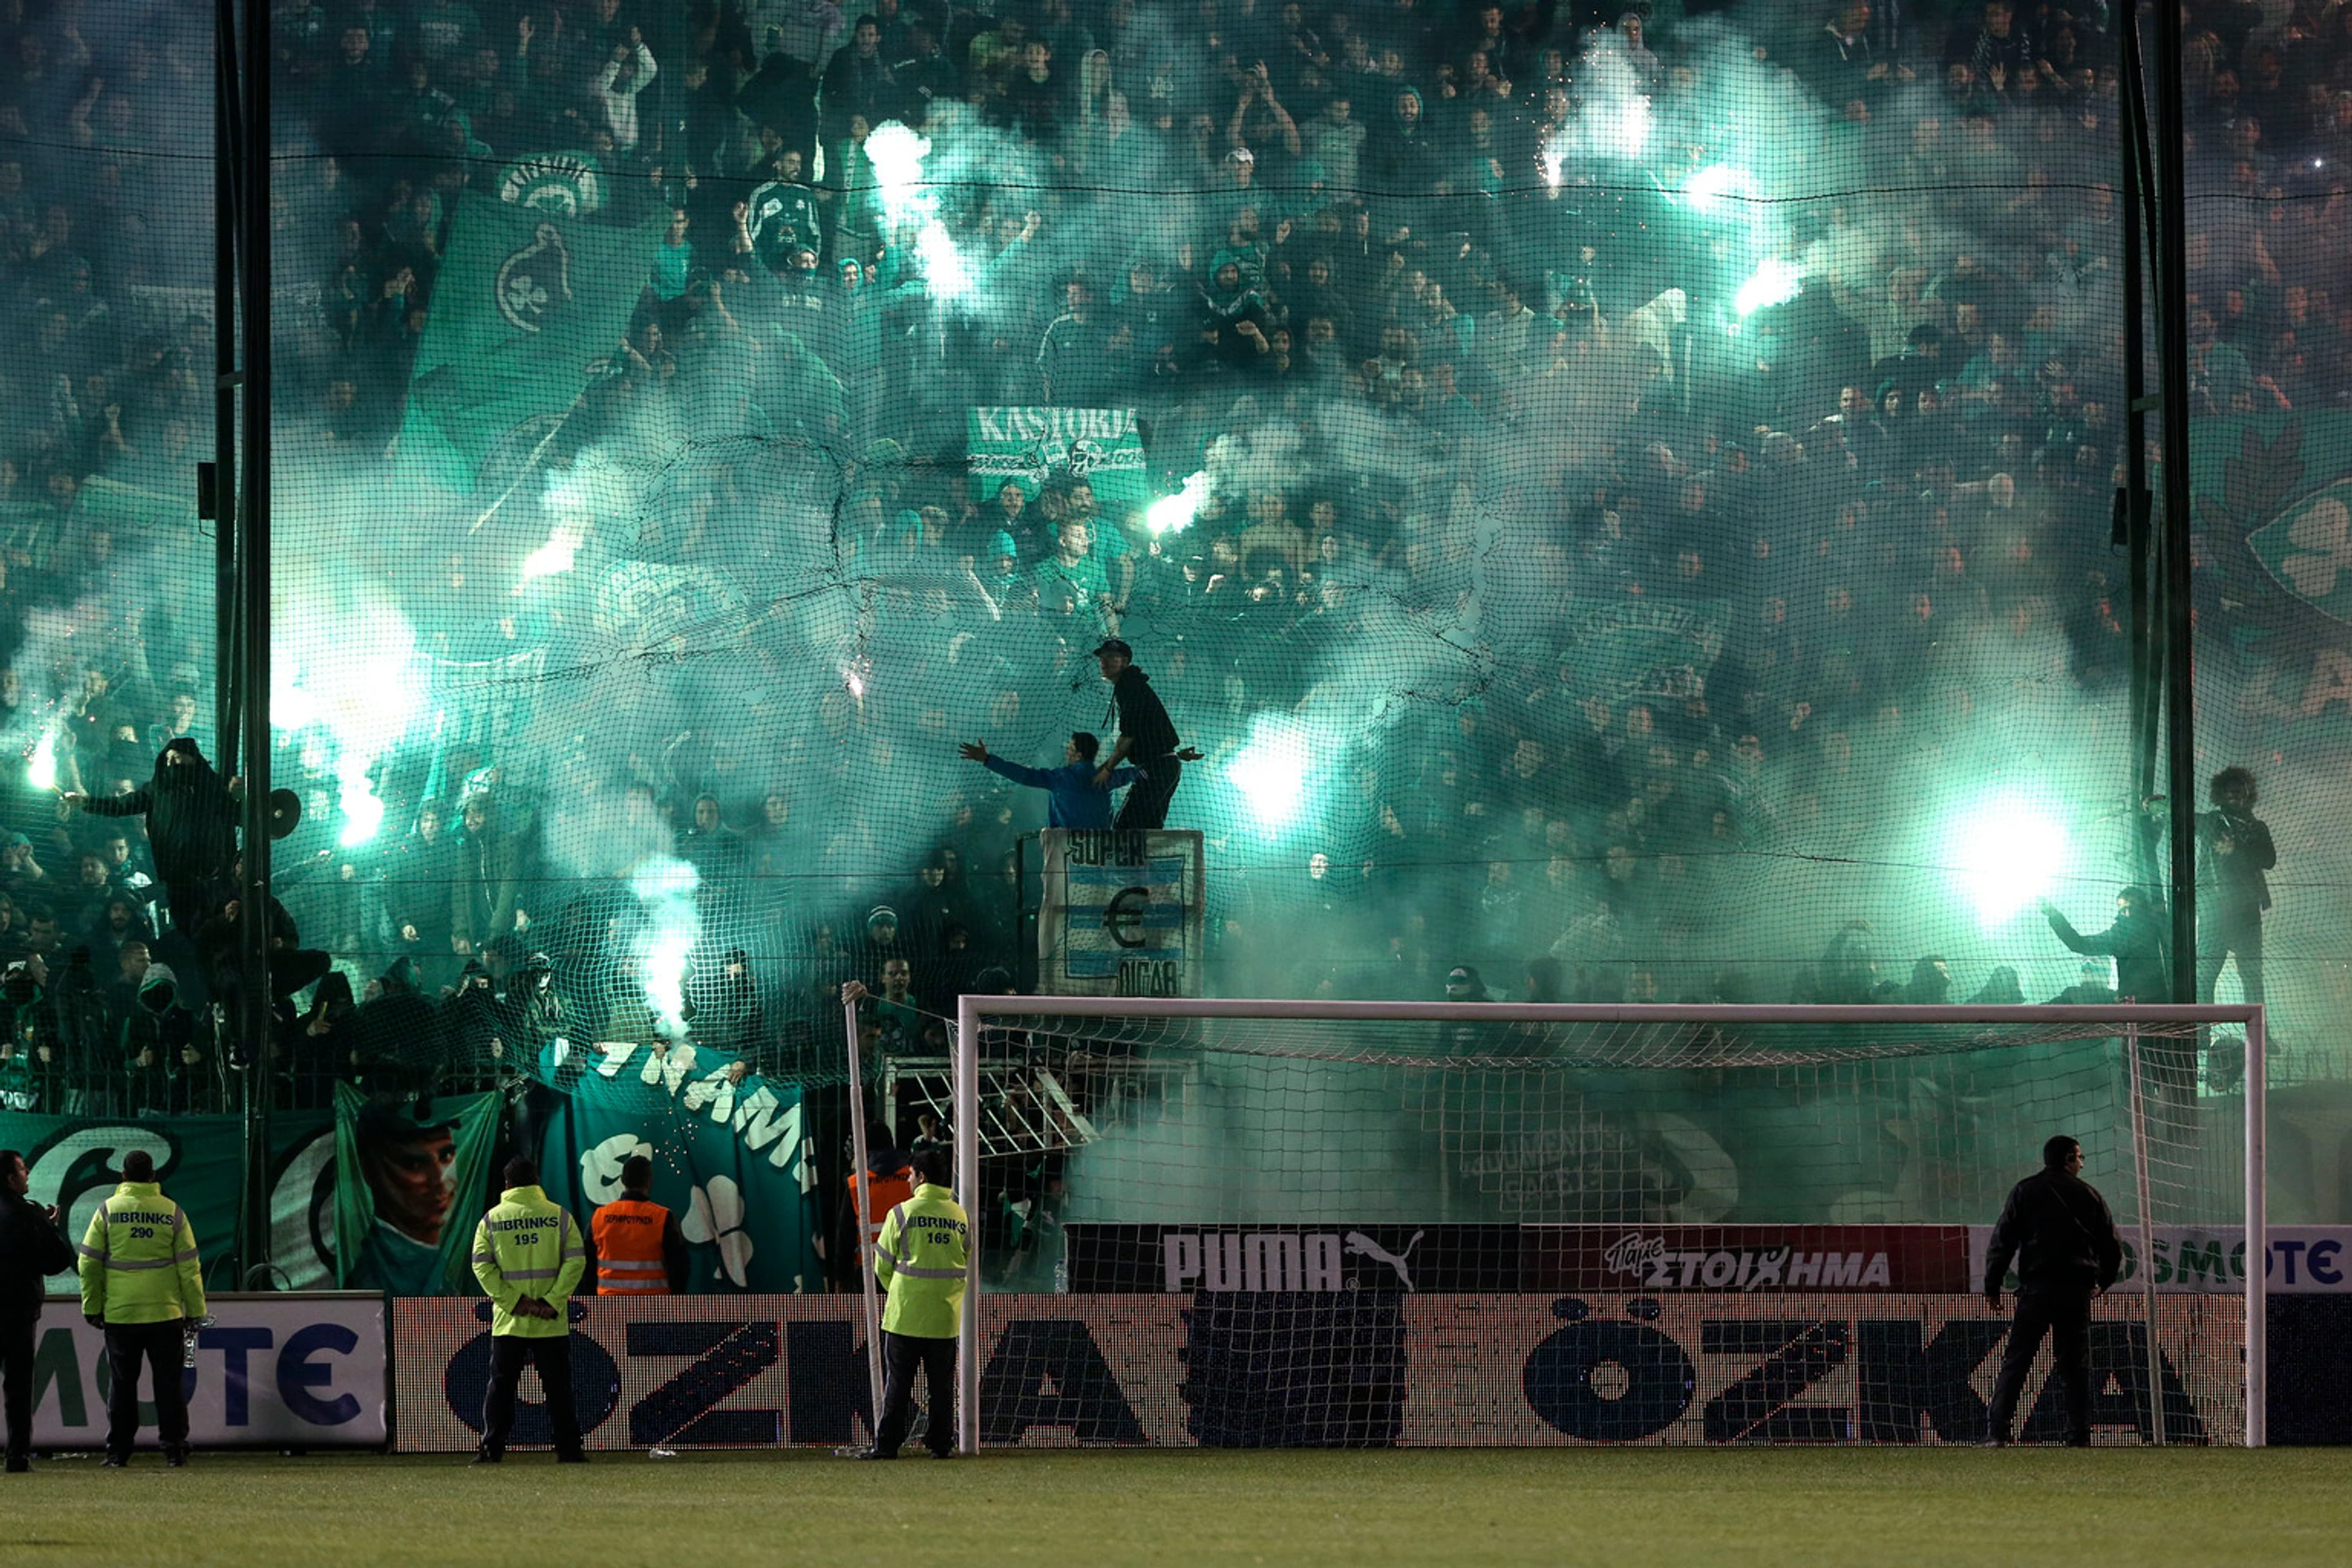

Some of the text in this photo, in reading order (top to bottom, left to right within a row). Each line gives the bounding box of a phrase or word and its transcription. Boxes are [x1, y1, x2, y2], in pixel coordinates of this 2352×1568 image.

[977, 407, 1138, 441] KASTORIA
[1070, 829, 1145, 866] SUPER
[119, 1212, 174, 1225] BRINKS
[504, 1217, 559, 1231] BRINKS
[917, 1215, 967, 1236] BRINKS
[130, 1227, 154, 1238] 290
[514, 1233, 539, 1245] 195
[928, 1232, 950, 1244] 165
[1164, 1234, 1342, 1292] PUMA
